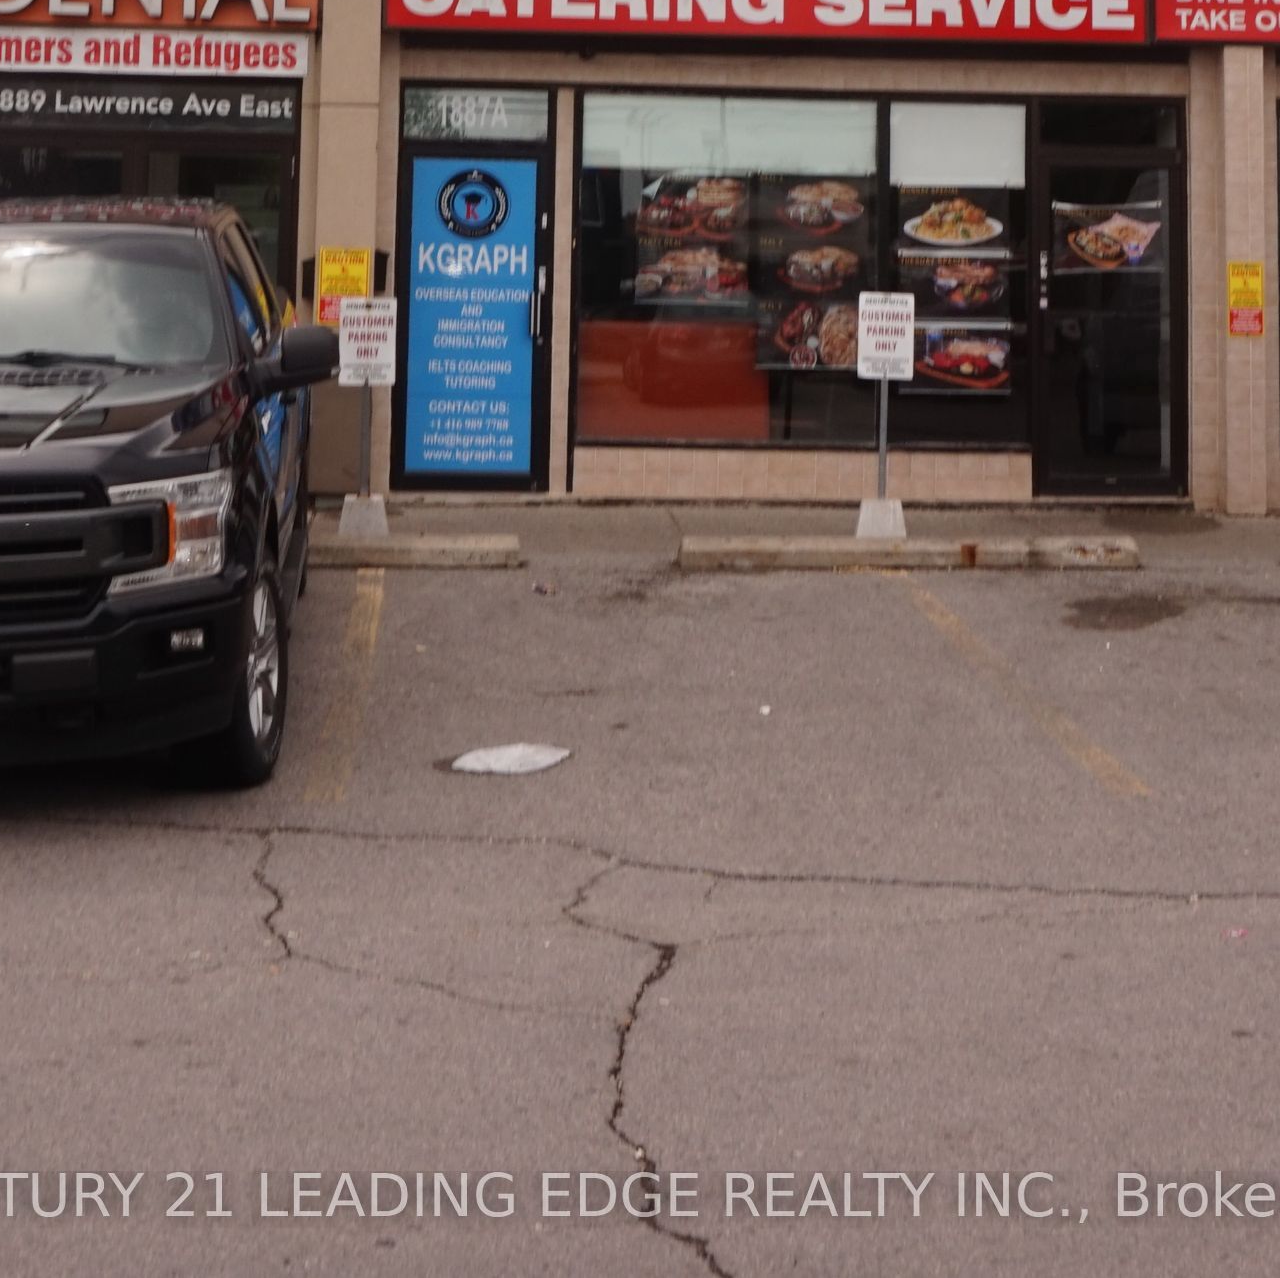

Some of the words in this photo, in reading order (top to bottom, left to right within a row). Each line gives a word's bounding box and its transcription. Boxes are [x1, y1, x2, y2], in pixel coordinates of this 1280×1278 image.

[1175, 9, 1246, 32] TAKE
[84, 32, 141, 67] and
[151, 35, 298, 73] Refugees
[54, 90, 173, 115] Lawrence
[181, 93, 232, 117] Ave
[239, 94, 294, 119] East
[438, 95, 508, 128] 1887A
[418, 242, 528, 276] KGRAPH
[415, 287, 468, 301] OVERSEAS
[471, 288, 529, 303] EDUCATION
[461, 303, 483, 316] AND
[861, 310, 912, 323] CUSTOMER
[342, 315, 394, 329] CUSTOMER
[437, 319, 505, 334] IMMIGRATION
[347, 330, 388, 343] PARKING
[866, 324, 906, 337] PARKING
[433, 334, 508, 349] CONSULTANCY
[875, 340, 898, 352] ONLY
[356, 347, 379, 359] ONLY
[428, 359, 456, 374] IELTS
[458, 359, 512, 374] COACHING
[444, 376, 496, 390] TUTORING
[428, 399, 486, 415] CONTACT
[423, 432, 514, 448] info@kgraph.ca
[423, 449, 514, 464] www.kgraph.ca
